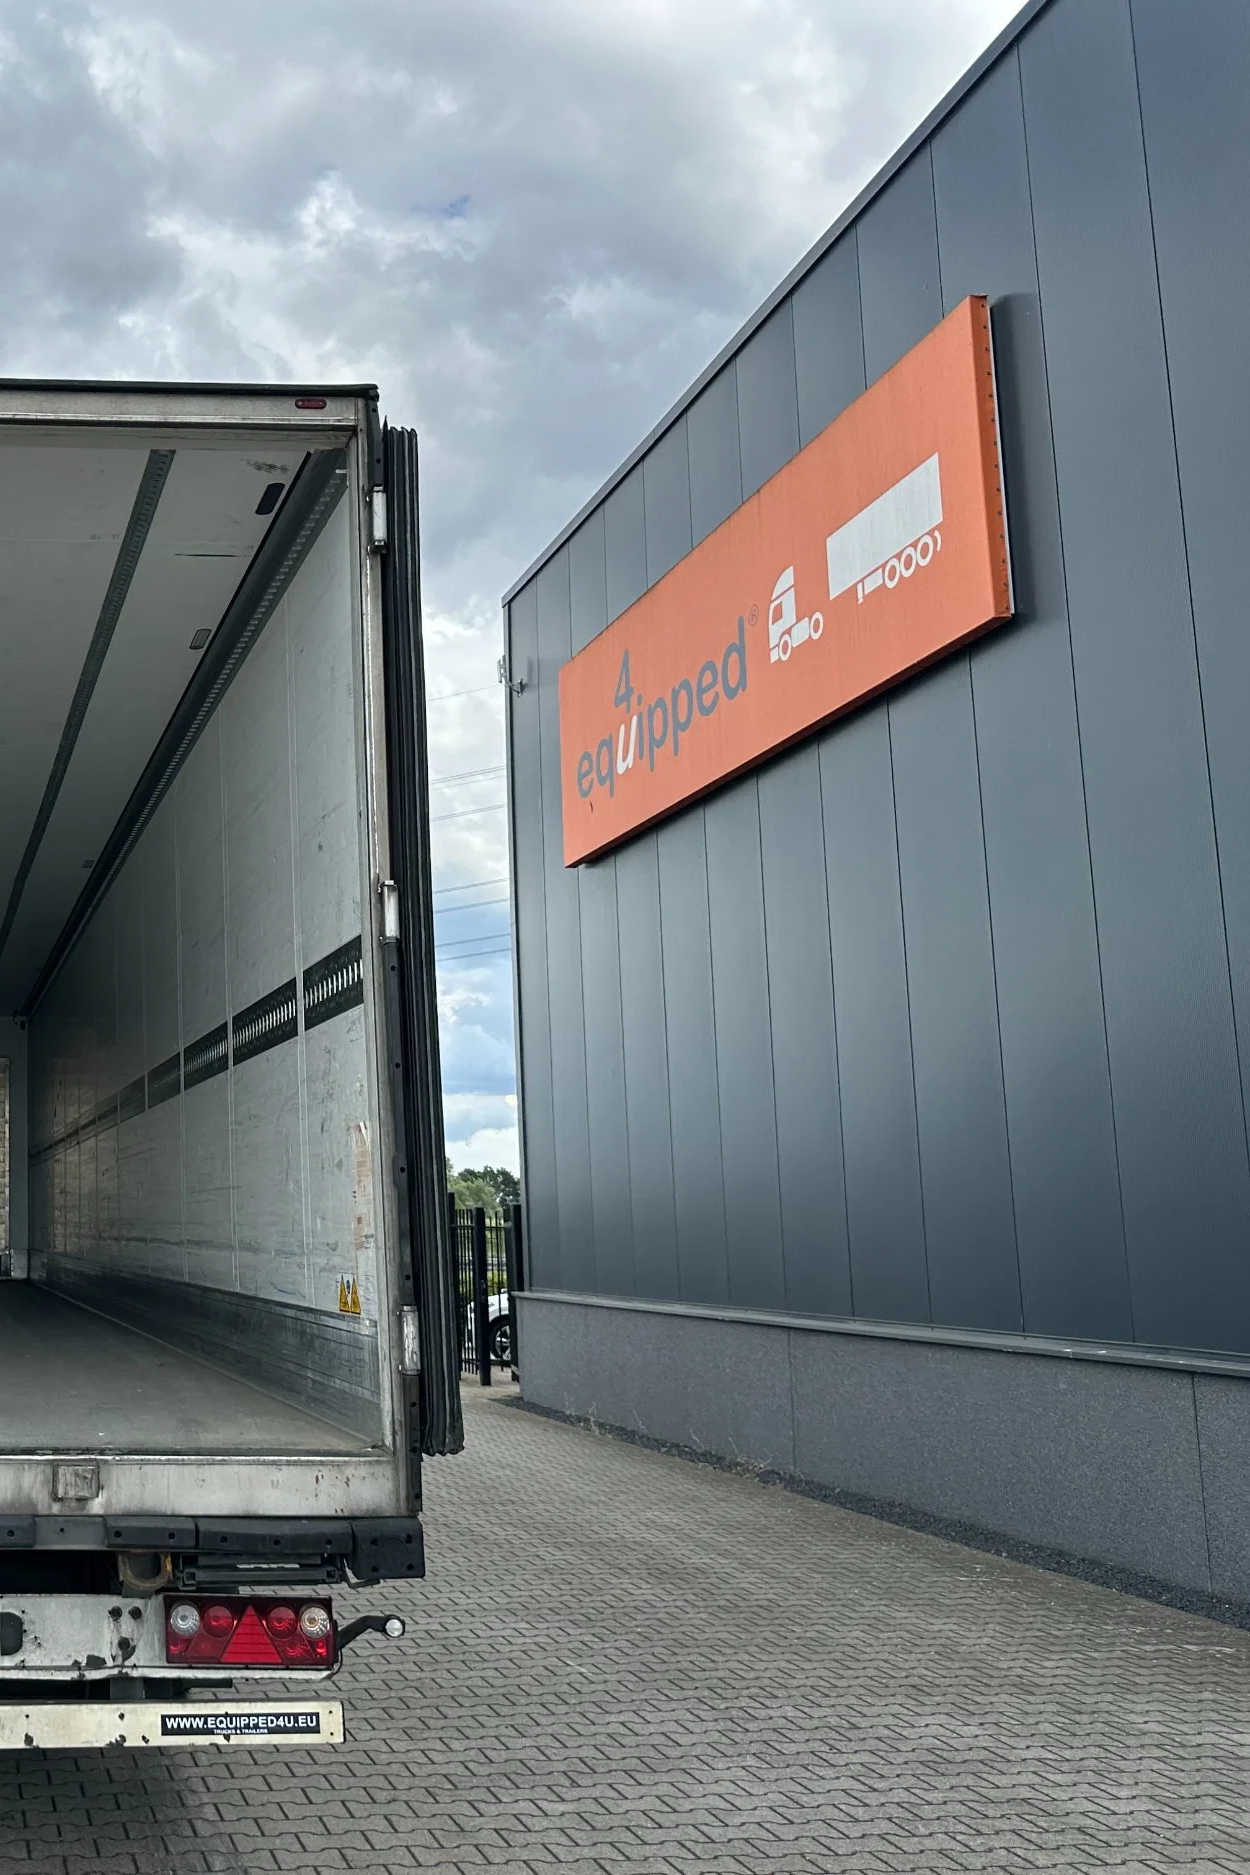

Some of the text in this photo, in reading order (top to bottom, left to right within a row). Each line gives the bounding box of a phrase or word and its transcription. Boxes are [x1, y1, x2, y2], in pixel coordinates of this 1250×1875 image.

[577, 614, 748, 798] equipped
[613, 649, 634, 714] 4
[165, 1715, 317, 1729] WWW.EQUIPPED4U.EU
